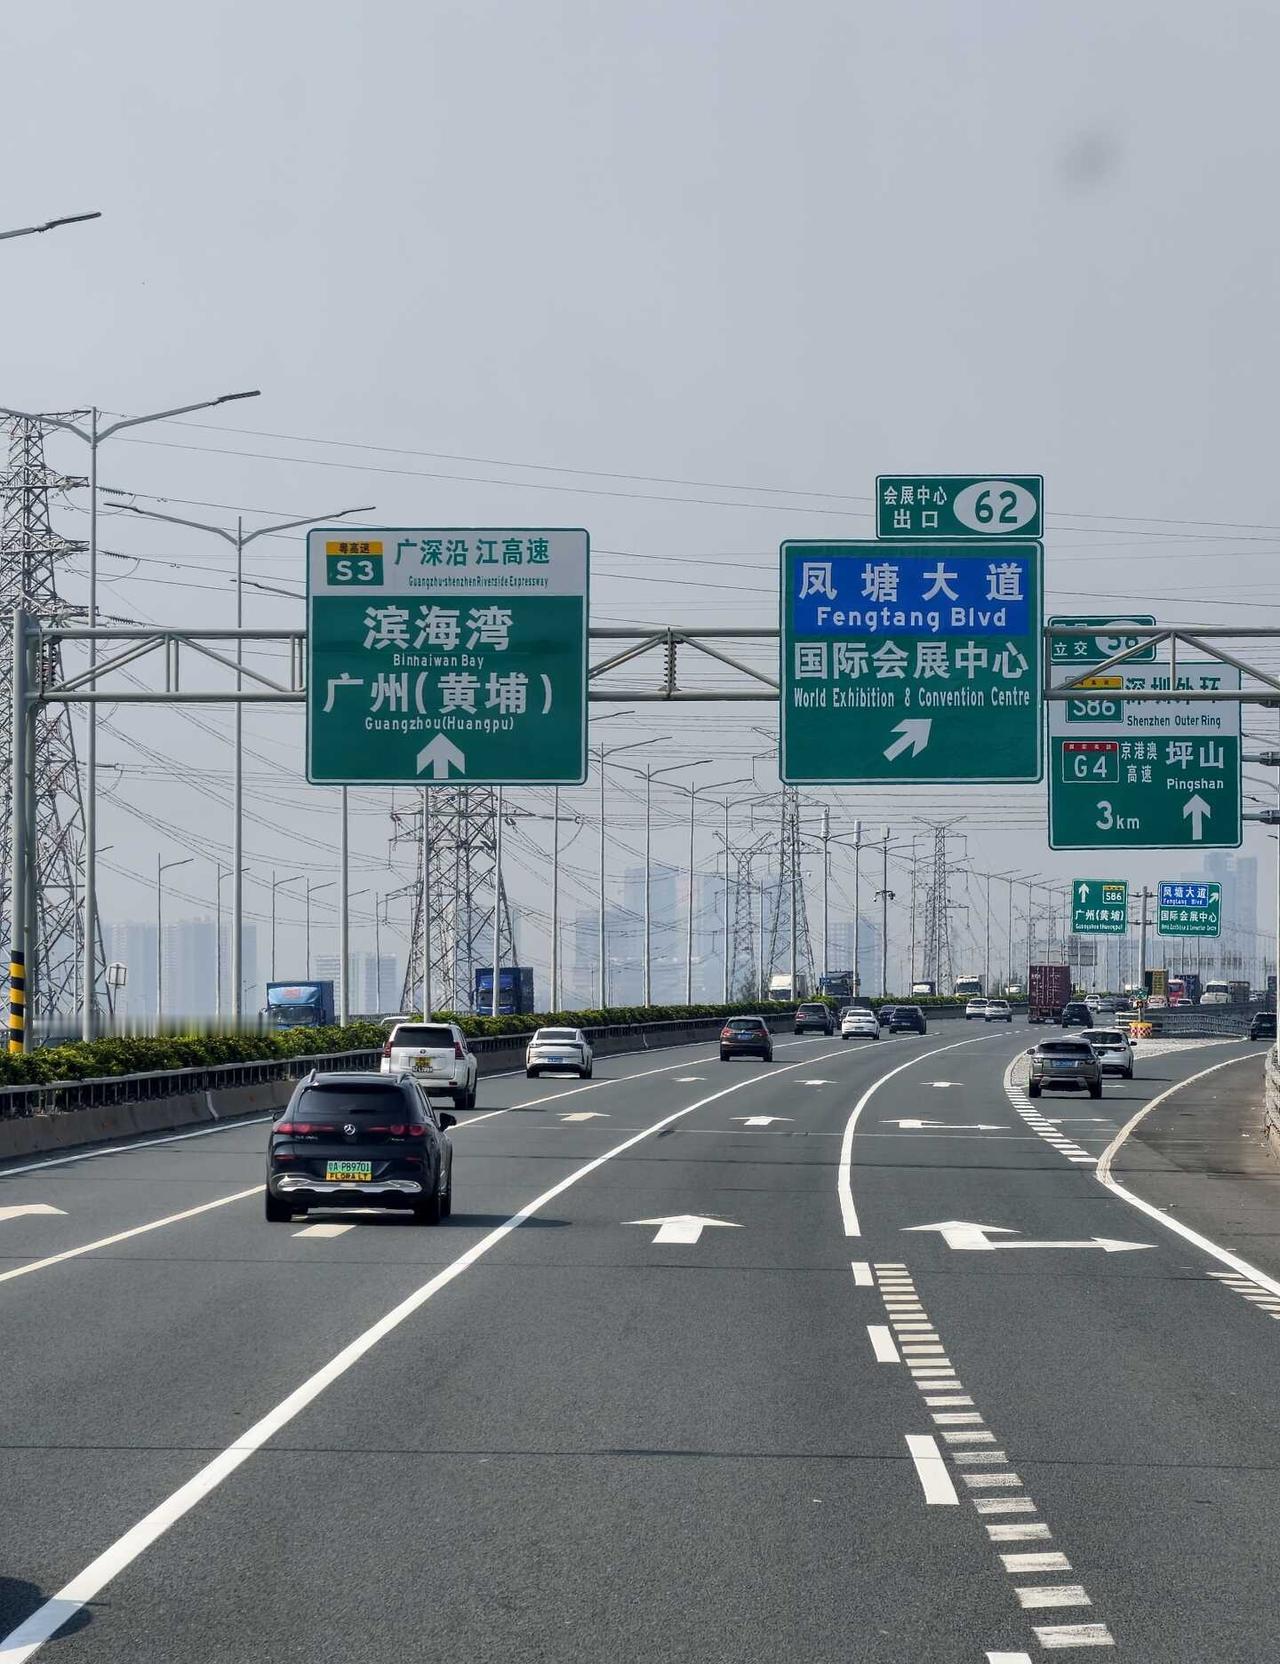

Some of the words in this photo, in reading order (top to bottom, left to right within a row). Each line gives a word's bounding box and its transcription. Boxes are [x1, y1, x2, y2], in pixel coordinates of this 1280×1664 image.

[884, 485, 948, 506] 会展中心
[974, 490, 1018, 524] 62
[893, 508, 938, 529] 出口
[394, 537, 551, 566] 广深沿江高速
[335, 560, 375, 581] S3
[798, 562, 1024, 602] 凤塘大道
[362, 604, 514, 651] 滨海湾
[817, 606, 940, 632] Fengtang
[950, 606, 1006, 627] Blvd
[1054, 641, 1088, 656] 立交
[394, 654, 458, 667] Binhaiwan
[462, 654, 484, 669] Bay
[794, 640, 1030, 679] 国际会展中心
[794, 687, 826, 707] World
[832, 687, 895, 707] Exhibition
[918, 687, 984, 706] Convention
[991, 687, 1030, 706] Centre
[1127, 715, 1170, 726] Shenzhen
[1174, 715, 1200, 726] Outer
[1201, 715, 1221, 729] Ring
[1120, 741, 1158, 761] 京港澳
[1165, 741, 1224, 770] 坪山
[1074, 754, 1108, 778] G4
[1126, 765, 1152, 783] 高速
[1166, 778, 1224, 792] Pingshan
